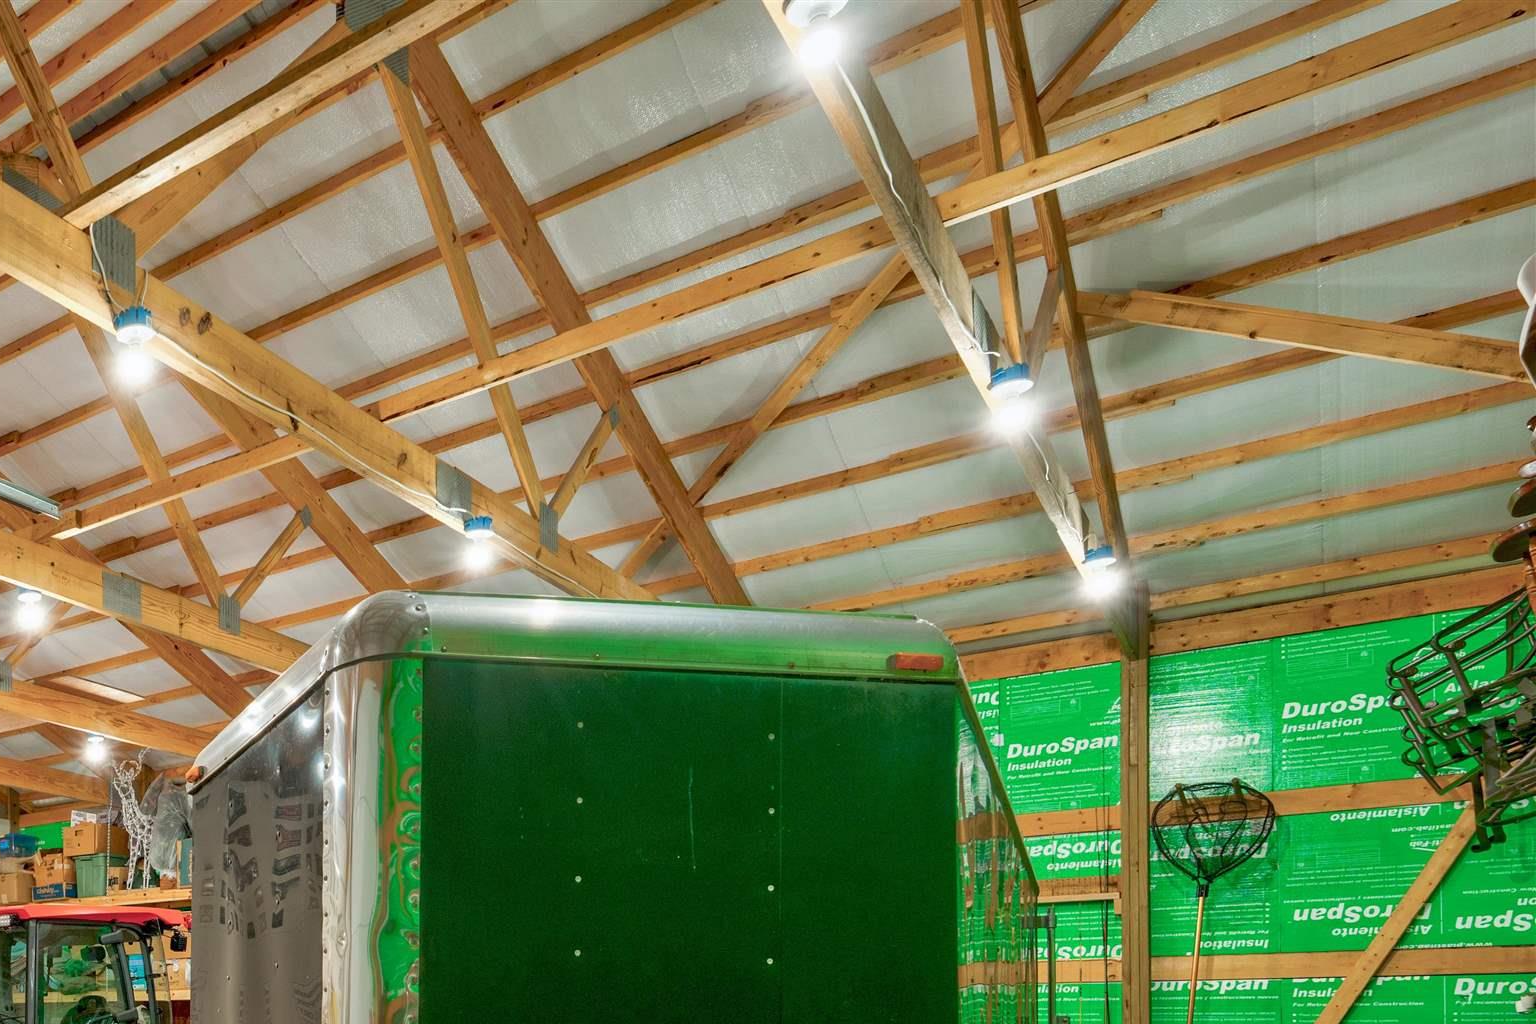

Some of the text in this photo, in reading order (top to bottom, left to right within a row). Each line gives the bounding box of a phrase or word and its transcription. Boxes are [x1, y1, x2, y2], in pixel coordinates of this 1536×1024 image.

[1282, 717, 1363, 734] Insulation
[1007, 735, 1119, 759] DuroSpan
[1007, 758, 1072, 772] Insulation
[1330, 806, 1431, 822] Aislamiento
